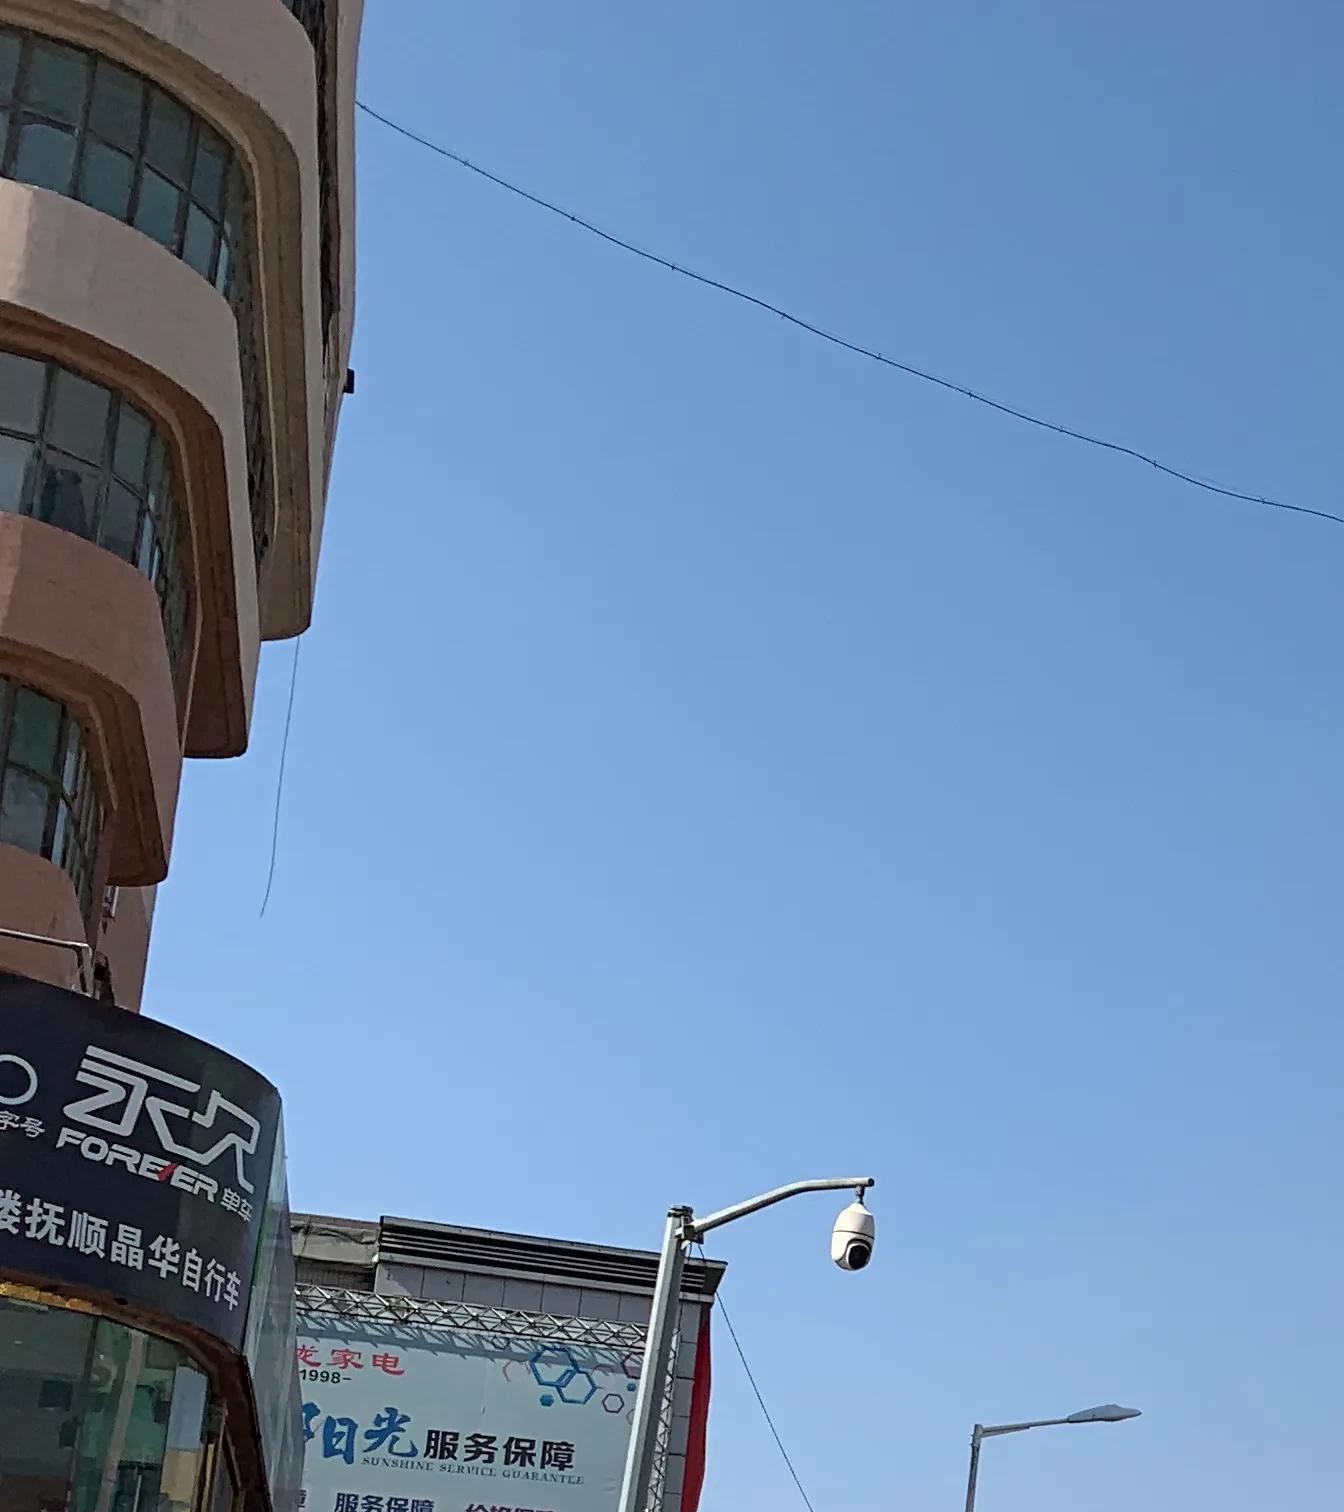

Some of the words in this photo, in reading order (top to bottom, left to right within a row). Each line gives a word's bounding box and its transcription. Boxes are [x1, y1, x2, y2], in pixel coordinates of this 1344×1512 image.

[56, 1127, 220, 1203] FOREVER
[360, 1457, 434, 1472] SUNSHINE
[424, 1429, 576, 1472] 服务保障
